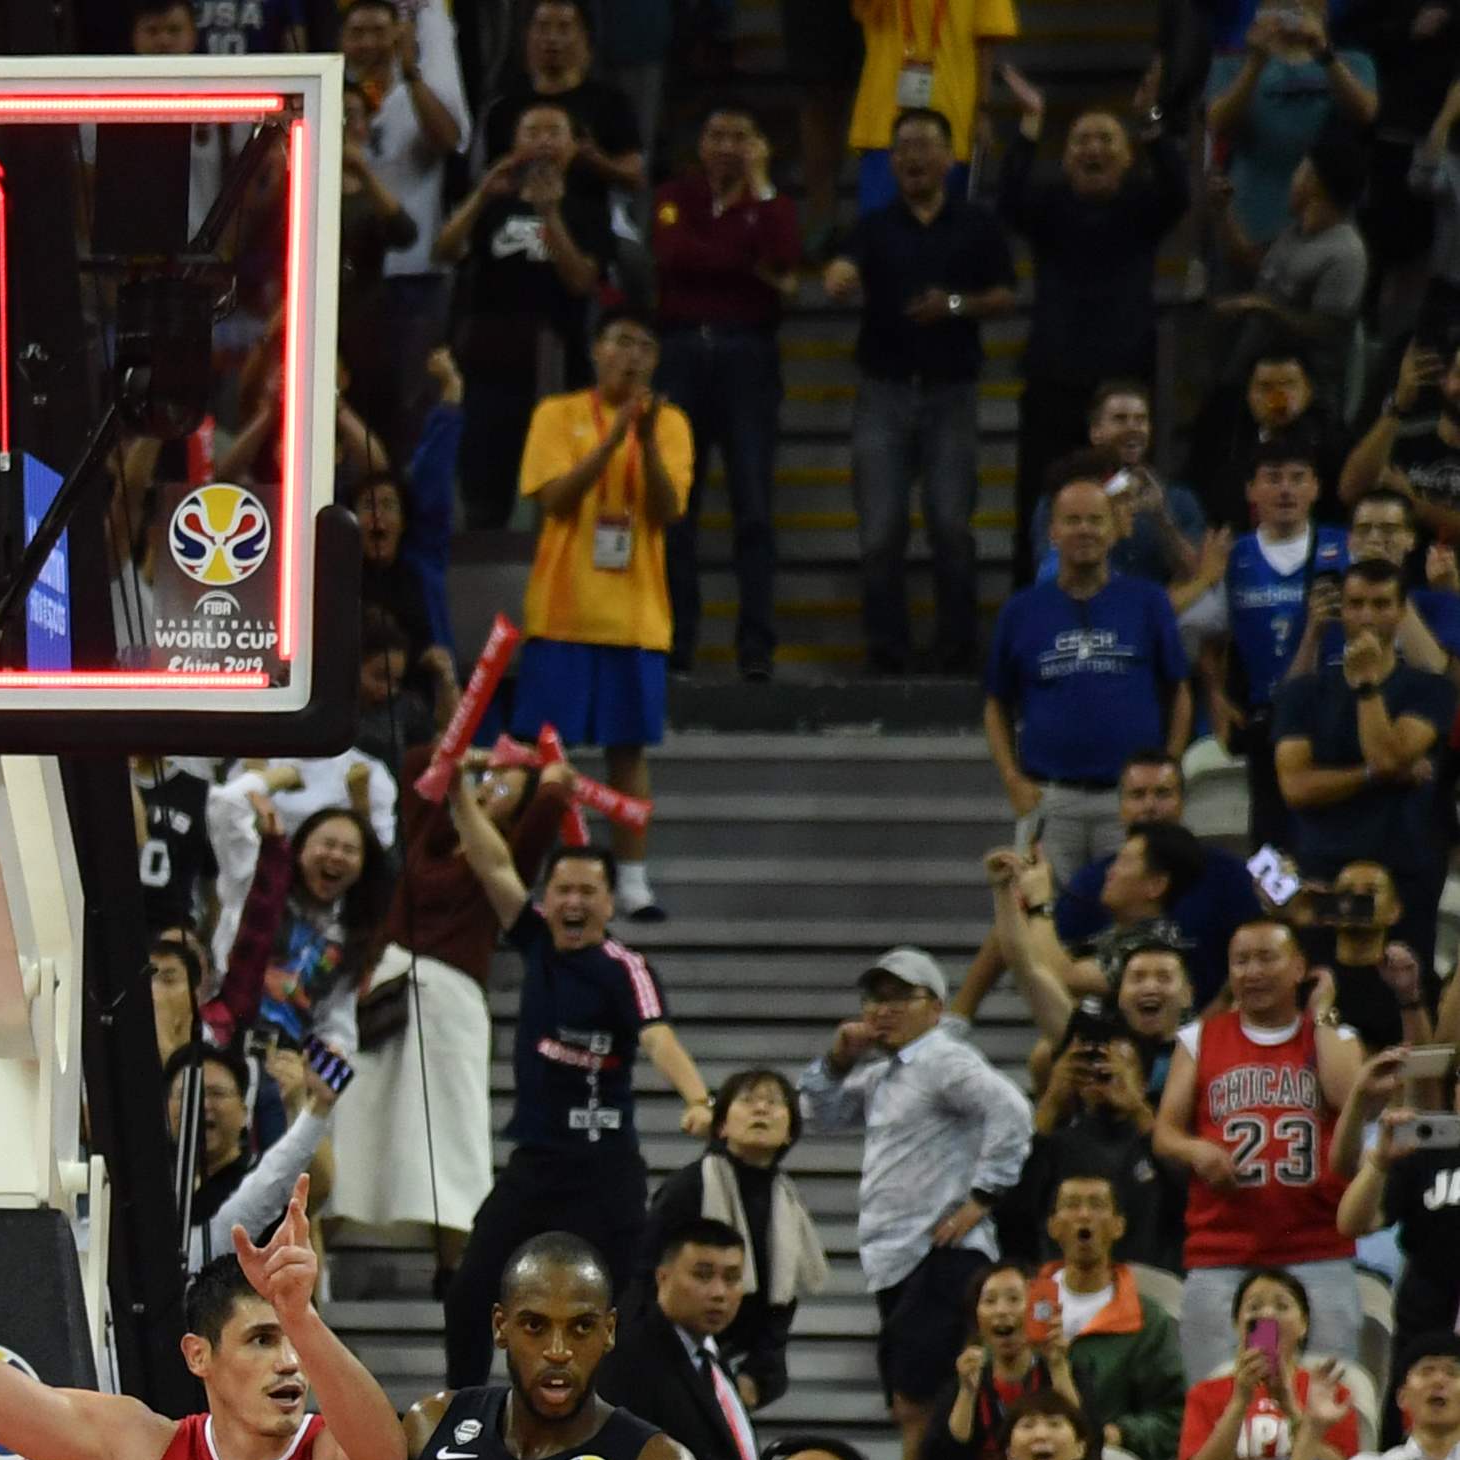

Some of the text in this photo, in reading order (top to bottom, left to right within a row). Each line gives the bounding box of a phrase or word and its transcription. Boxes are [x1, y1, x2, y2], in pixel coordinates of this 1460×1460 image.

[203, 601, 231, 615] FIBA
[155, 619, 276, 629] BASKETBALL
[154, 631, 279, 650] WORLD CUP
[167, 656, 263, 674] China 2019
[1209, 1062, 1319, 1126] CHICAG
[1225, 1116, 1317, 1188] 23
